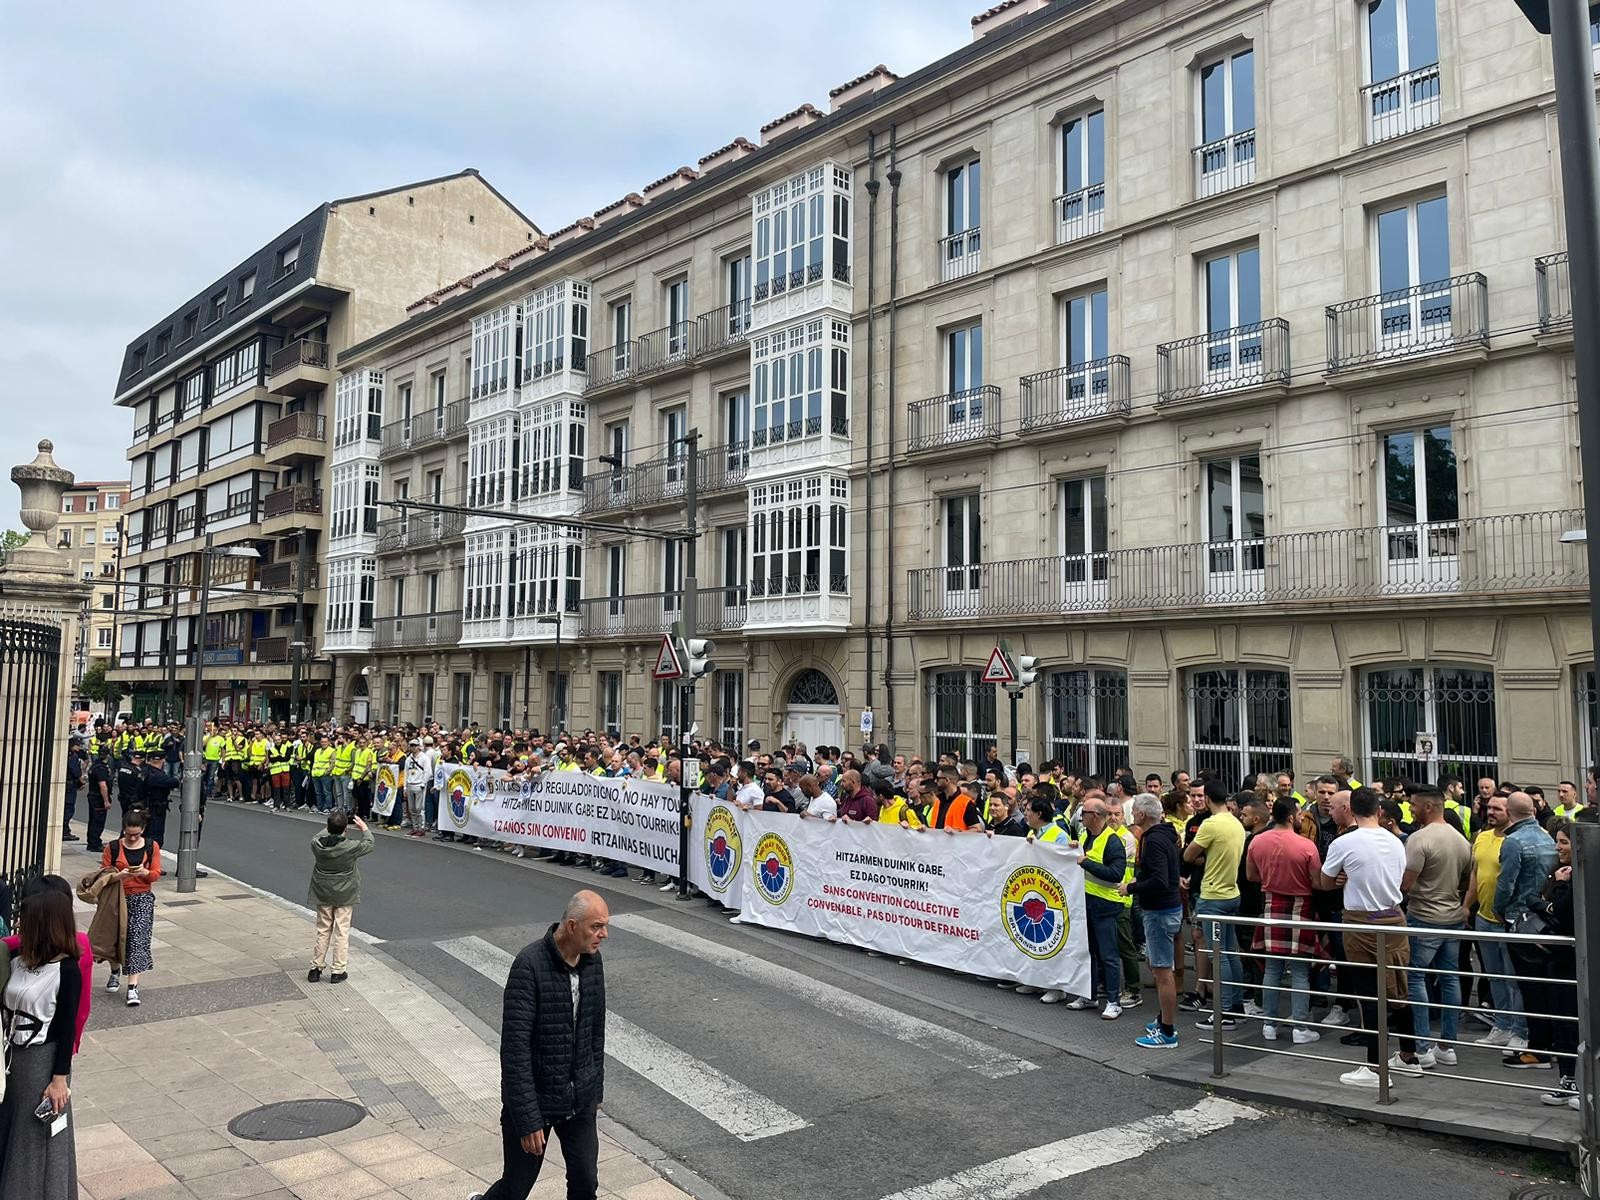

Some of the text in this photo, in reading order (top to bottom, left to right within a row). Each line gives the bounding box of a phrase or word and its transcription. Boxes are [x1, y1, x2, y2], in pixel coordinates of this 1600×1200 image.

[545, 781, 592, 797] REGULADOR
[594, 784, 621, 804] DIGNO,
[623, 791, 639, 805] NO
[641, 794, 660, 808] HAY
[501, 797, 680, 836] HITZARMEN DUINIK GABE EZ DAGO TOURRIK!
[493, 819, 503, 832] 12
[503, 818, 526, 835] AÑOS
[527, 822, 541, 836] SIN
[543, 824, 587, 842] CONVENIO
[639, 841, 651, 858] EN
[653, 846, 681, 865] LUCH
[765, 841, 774, 850] HAY
[775, 842, 788, 862] TOUR
[835, 851, 946, 878] HITZARMEN DUINIK GABE,
[850, 870, 929, 892] EZ DAGO TOURRIK!
[1009, 867, 1035, 885] ACUERDO
[1036, 868, 1066, 909] REGULADOR
[1011, 877, 1061, 904] NO HAY TOUR
[823, 884, 960, 919] SANS CONVENTION COLLECTIVE
[867, 909, 884, 922] PAS
[886, 912, 897, 924] DU
[898, 915, 923, 930] TOUR
[924, 920, 937, 932] DE
[937, 922, 980, 941] FRANCE!
[1038, 945, 1048, 953] EN
[1049, 923, 1063, 949] LUCHA
